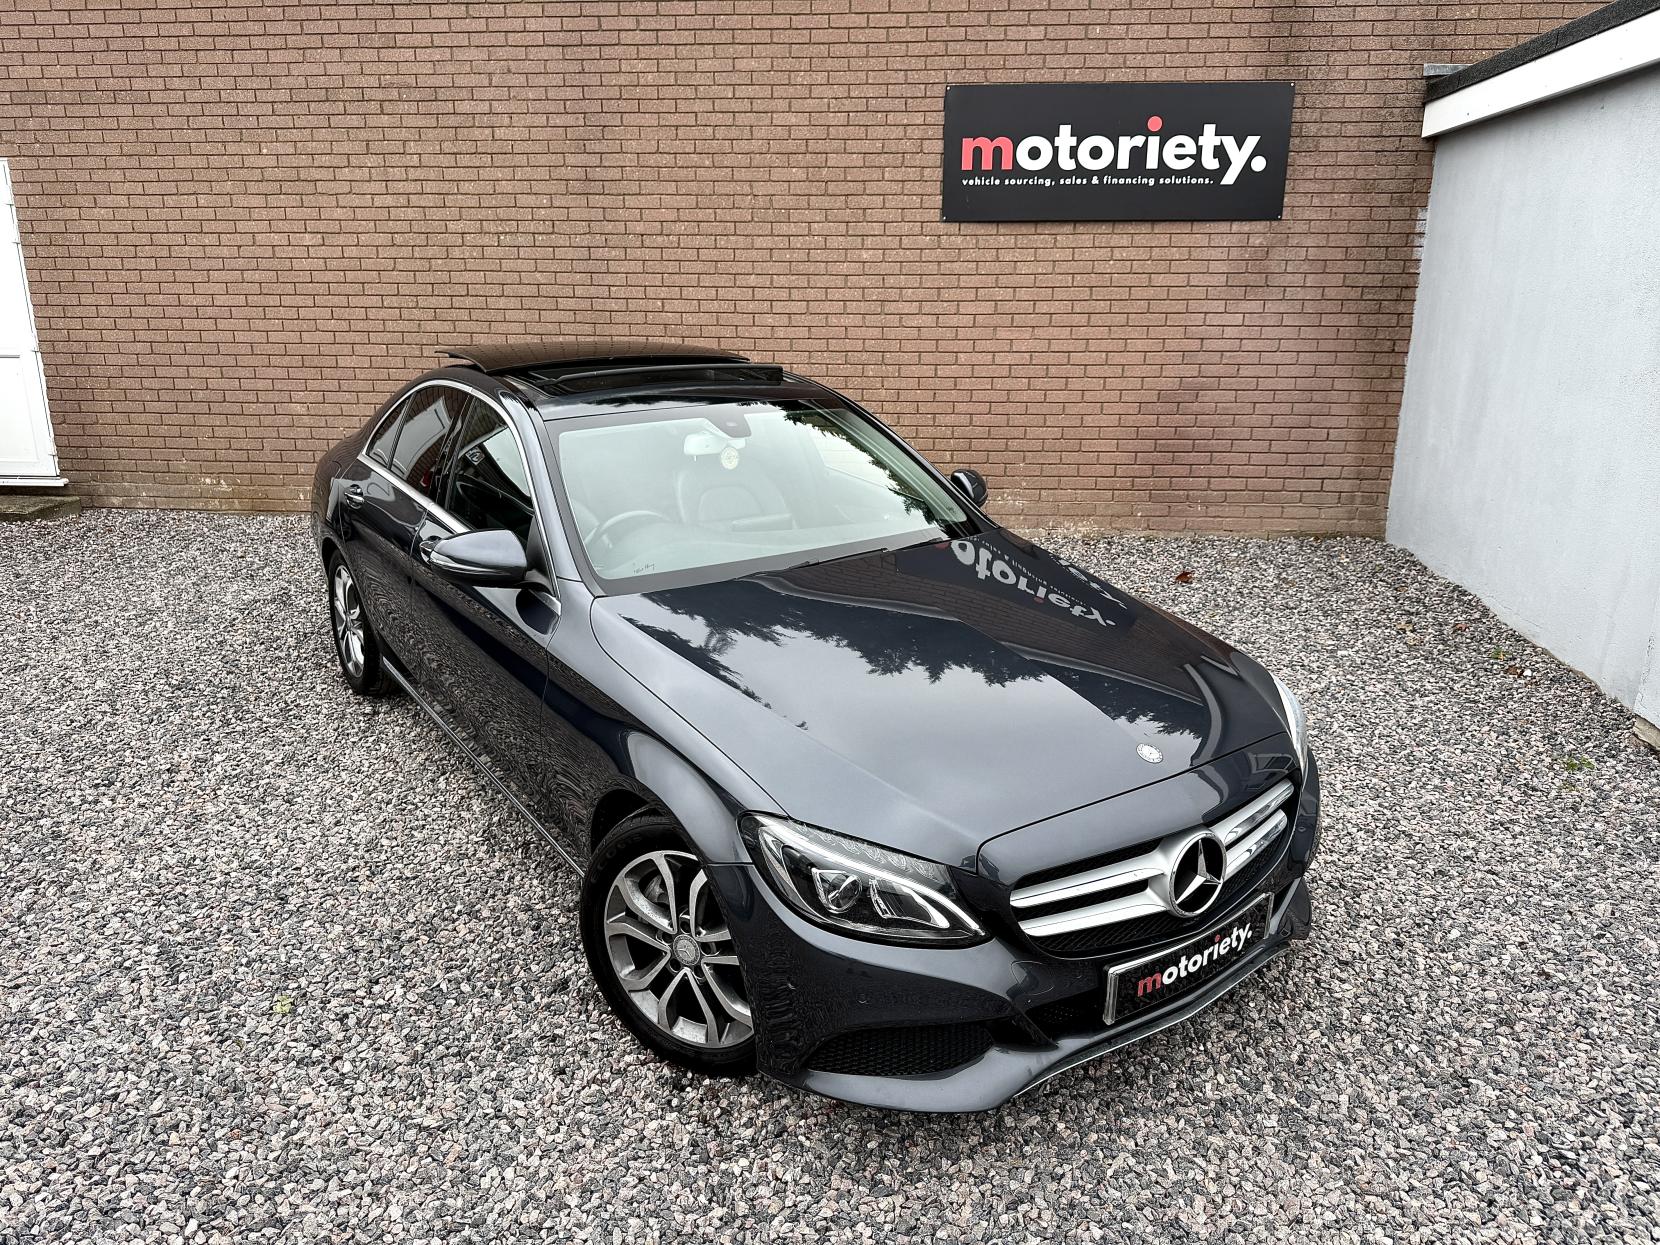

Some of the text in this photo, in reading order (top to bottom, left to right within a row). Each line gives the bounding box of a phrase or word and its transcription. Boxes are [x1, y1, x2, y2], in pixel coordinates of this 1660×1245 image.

[961, 115, 1267, 185] motoriety.
[961, 174, 1214, 187] vehicle sourcing, sales & financing solutions.
[1137, 922, 1252, 997] motoriety.
